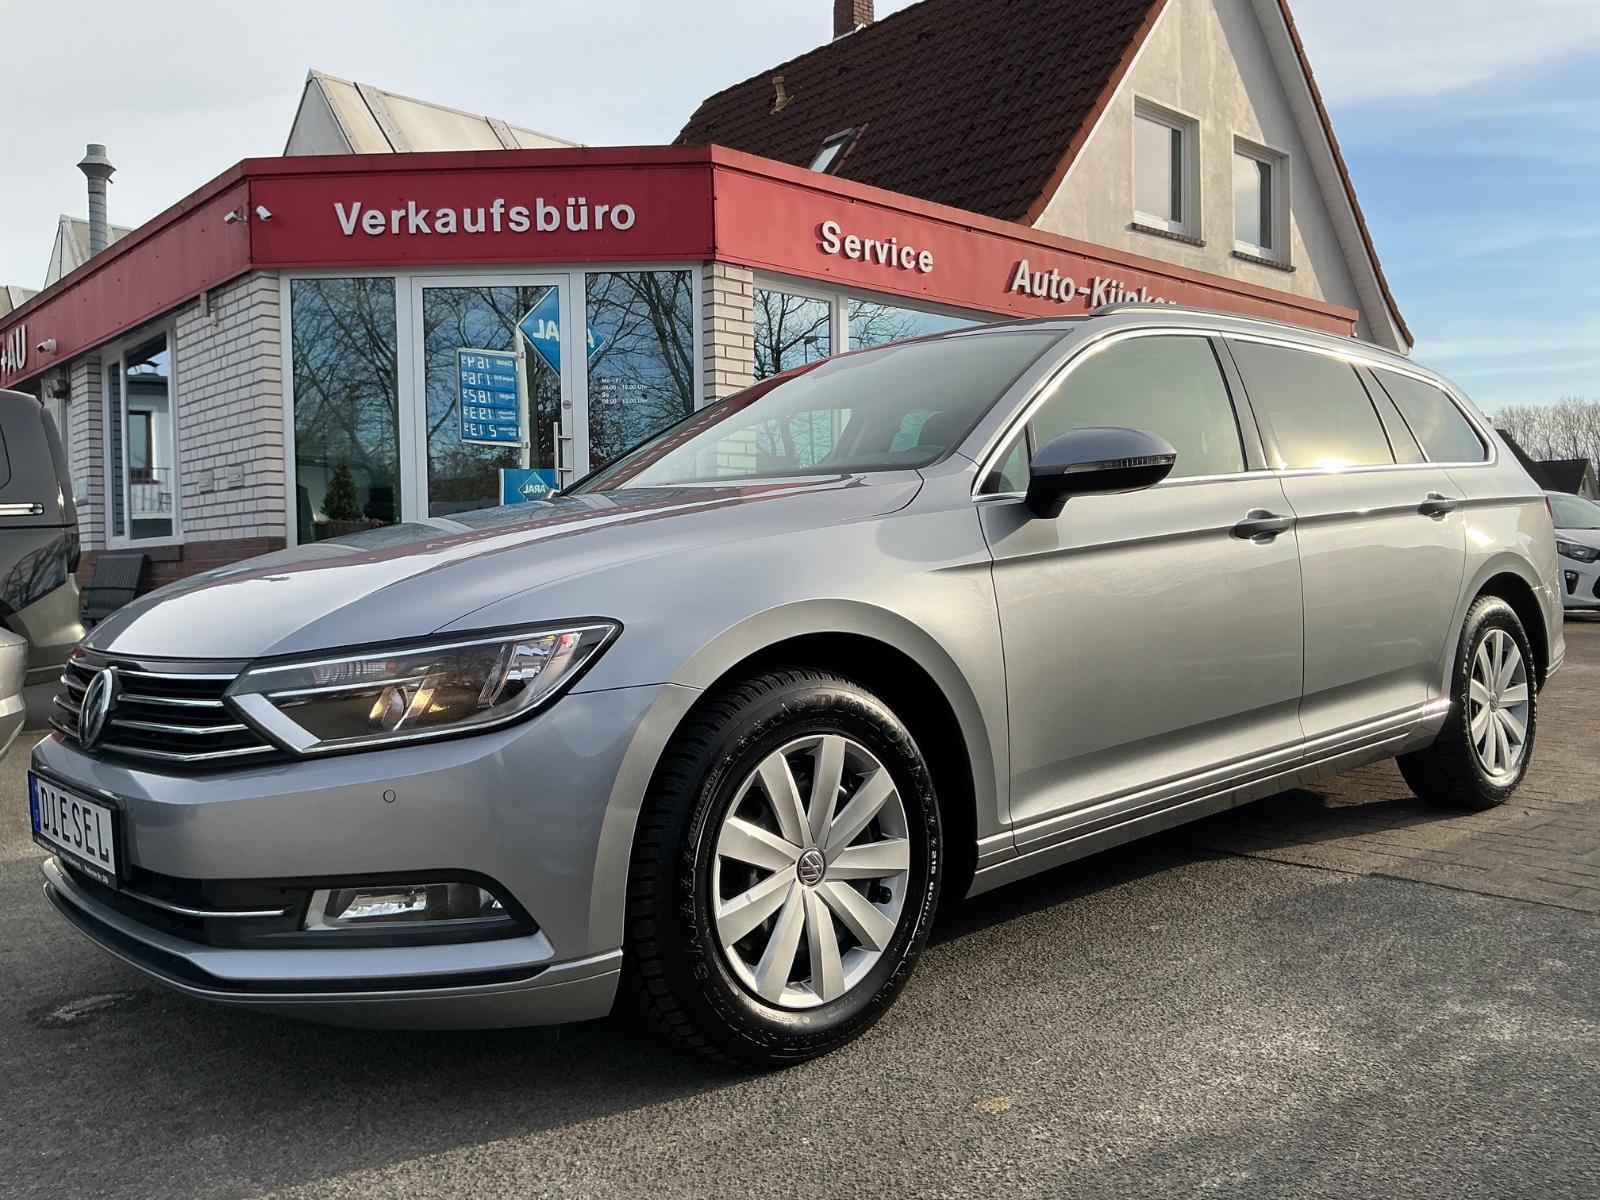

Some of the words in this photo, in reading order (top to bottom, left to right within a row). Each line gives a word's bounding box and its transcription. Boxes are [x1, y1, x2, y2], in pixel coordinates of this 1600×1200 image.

[333, 197, 636, 236] Verkaufsbüro
[821, 220, 934, 273] Service
[40, 786, 110, 864] DIESEL
